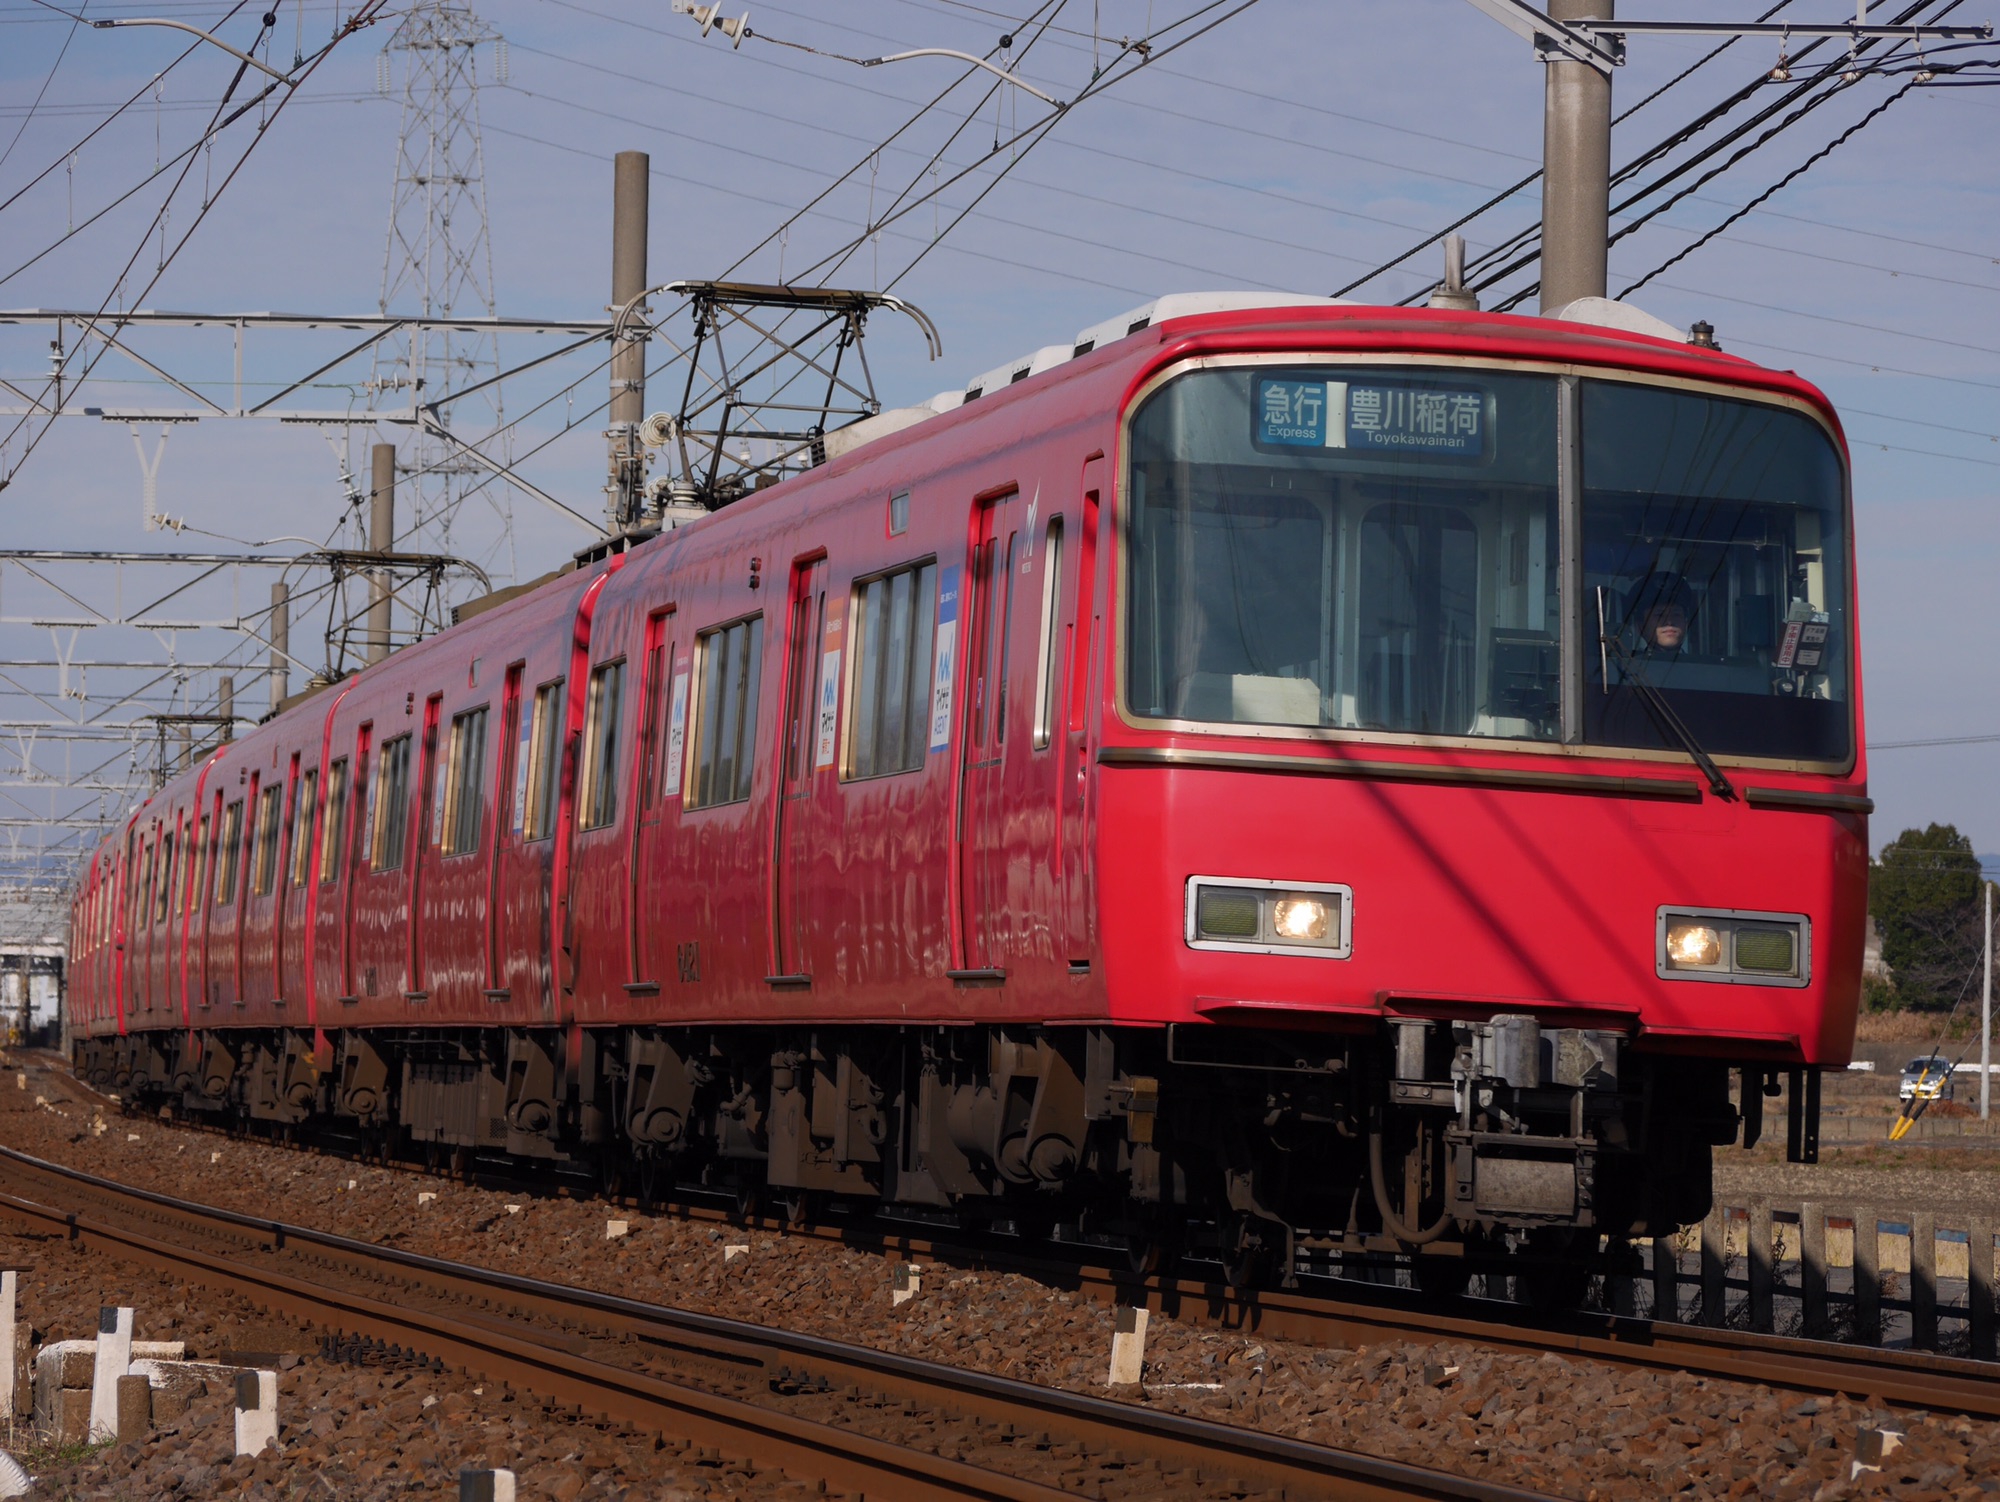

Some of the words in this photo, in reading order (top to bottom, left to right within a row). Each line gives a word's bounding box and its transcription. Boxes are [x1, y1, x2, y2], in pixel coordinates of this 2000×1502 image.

[1263, 384, 1322, 427] 急行
[1350, 389, 1481, 436] 豊川稲荷
[1267, 425, 1317, 440] Express
[1365, 430, 1465, 448] Toyokawainari
